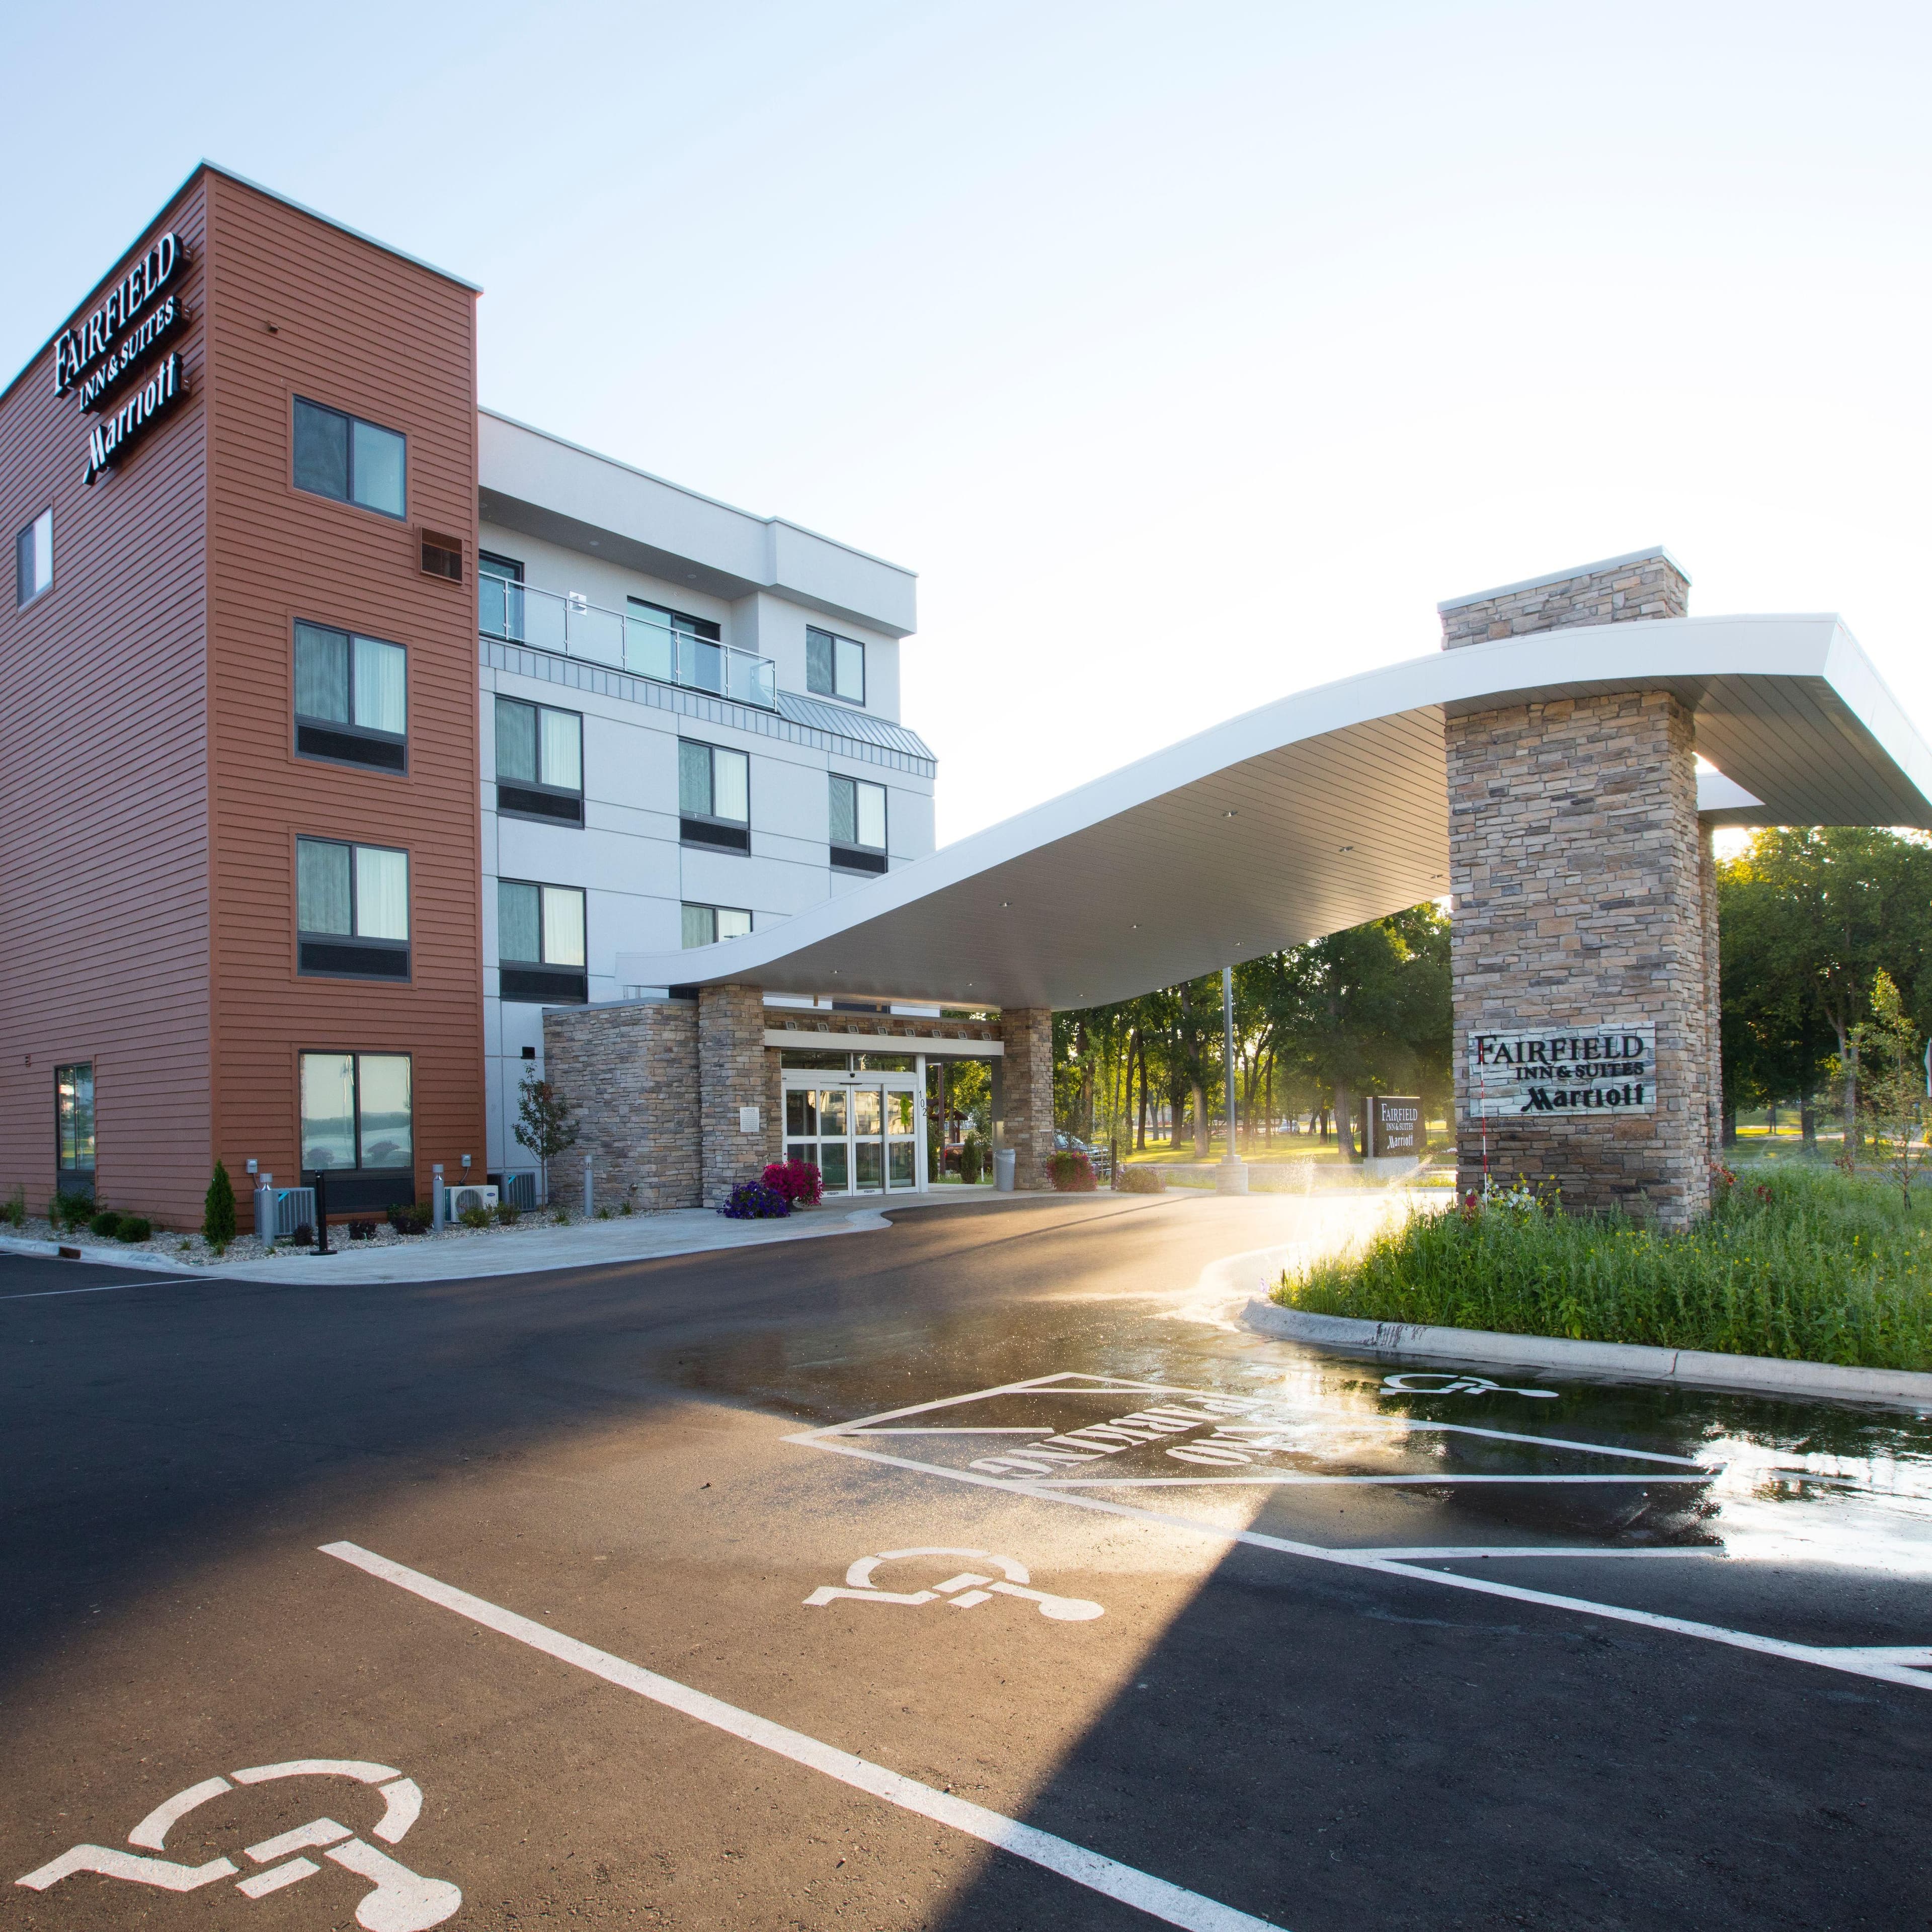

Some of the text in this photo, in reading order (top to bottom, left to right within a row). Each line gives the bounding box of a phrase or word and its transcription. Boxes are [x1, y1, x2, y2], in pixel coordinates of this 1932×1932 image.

[54, 232, 176, 396] FAIRFIELD
[120, 295, 175, 367] SUITES
[83, 352, 176, 485] Marriott
[1475, 1034, 1644, 1065] FAIRFIELD
[1516, 1066, 1555, 1080] INN
[1575, 1062, 1644, 1078] SUITES
[1381, 1103, 1417, 1122] FAIRFIELD
[1520, 1083, 1644, 1112] Marriott
[1387, 1135, 1413, 1150] Marriott
